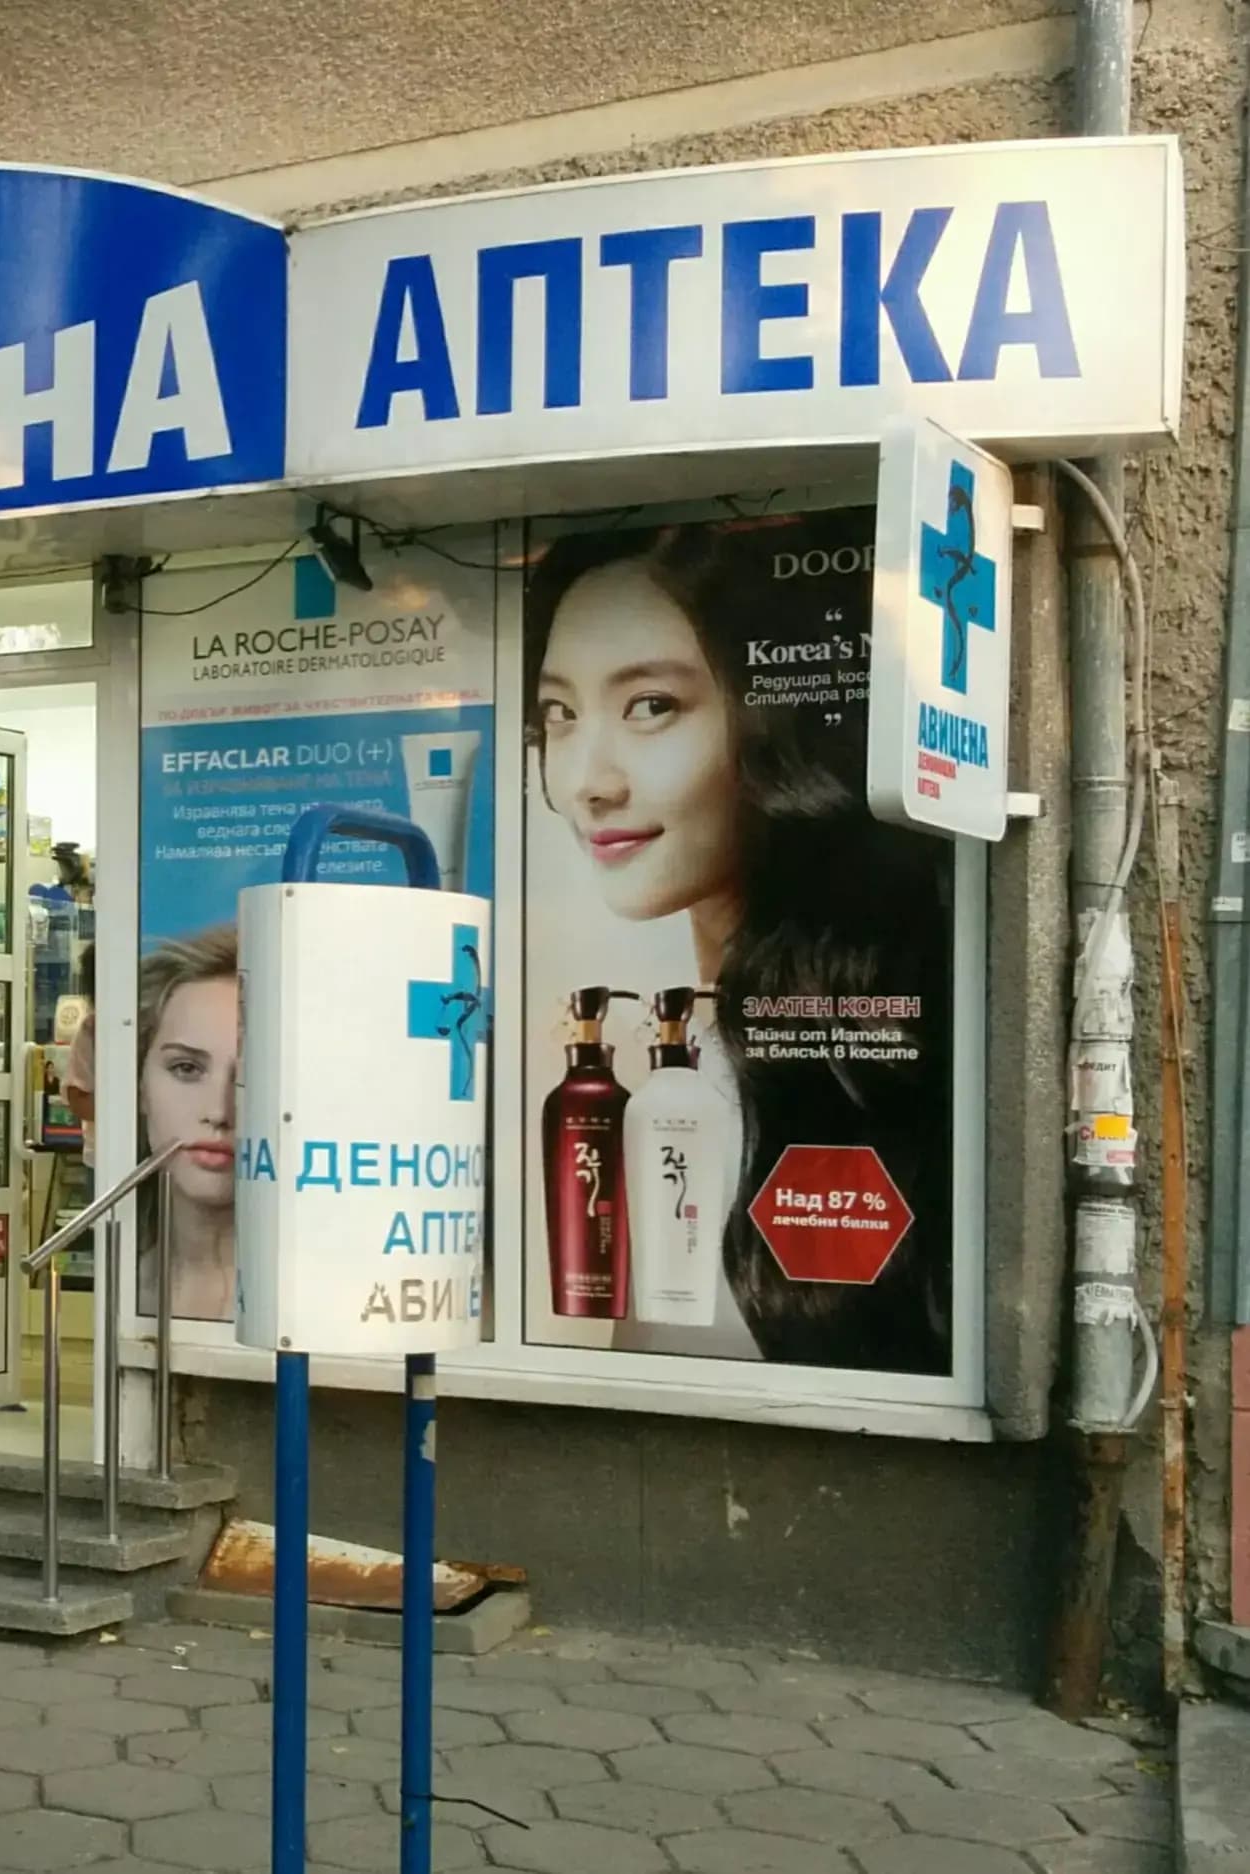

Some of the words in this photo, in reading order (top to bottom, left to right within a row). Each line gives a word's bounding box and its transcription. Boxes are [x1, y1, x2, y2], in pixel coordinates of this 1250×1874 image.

[355, 200, 1082, 429] АПТЕКА
[193, 636, 226, 659] LA
[235, 614, 445, 655] ROCHE-POSAY
[746, 634, 853, 666] Korea's
[193, 659, 293, 681] LABORATOIRE
[298, 647, 445, 673] DERMATOLOGIQUE
[918, 701, 989, 769] АВИЦЕНА
[162, 747, 291, 774] EFFACLAR
[296, 742, 350, 765] DUO
[263, 824, 291, 836] сле
[742, 996, 833, 1018] ЗЛАТЕН
[837, 996, 921, 1018] КОРЕН
[744, 1027, 796, 1042] Тайни
[800, 1029, 827, 1042] от
[831, 1027, 903, 1043] Изтока
[745, 1046, 765, 1058] за
[769, 1044, 830, 1059] блясък
[850, 1046, 919, 1060] косите
[296, 1141, 485, 1193] ДЕНОНО
[775, 1188, 823, 1212] Над
[828, 1191, 857, 1209] 87
[862, 1192, 886, 1211] %
[383, 1211, 484, 1255] АПТЕ
[772, 1214, 838, 1228] лечебни
[840, 1215, 890, 1230] билки
